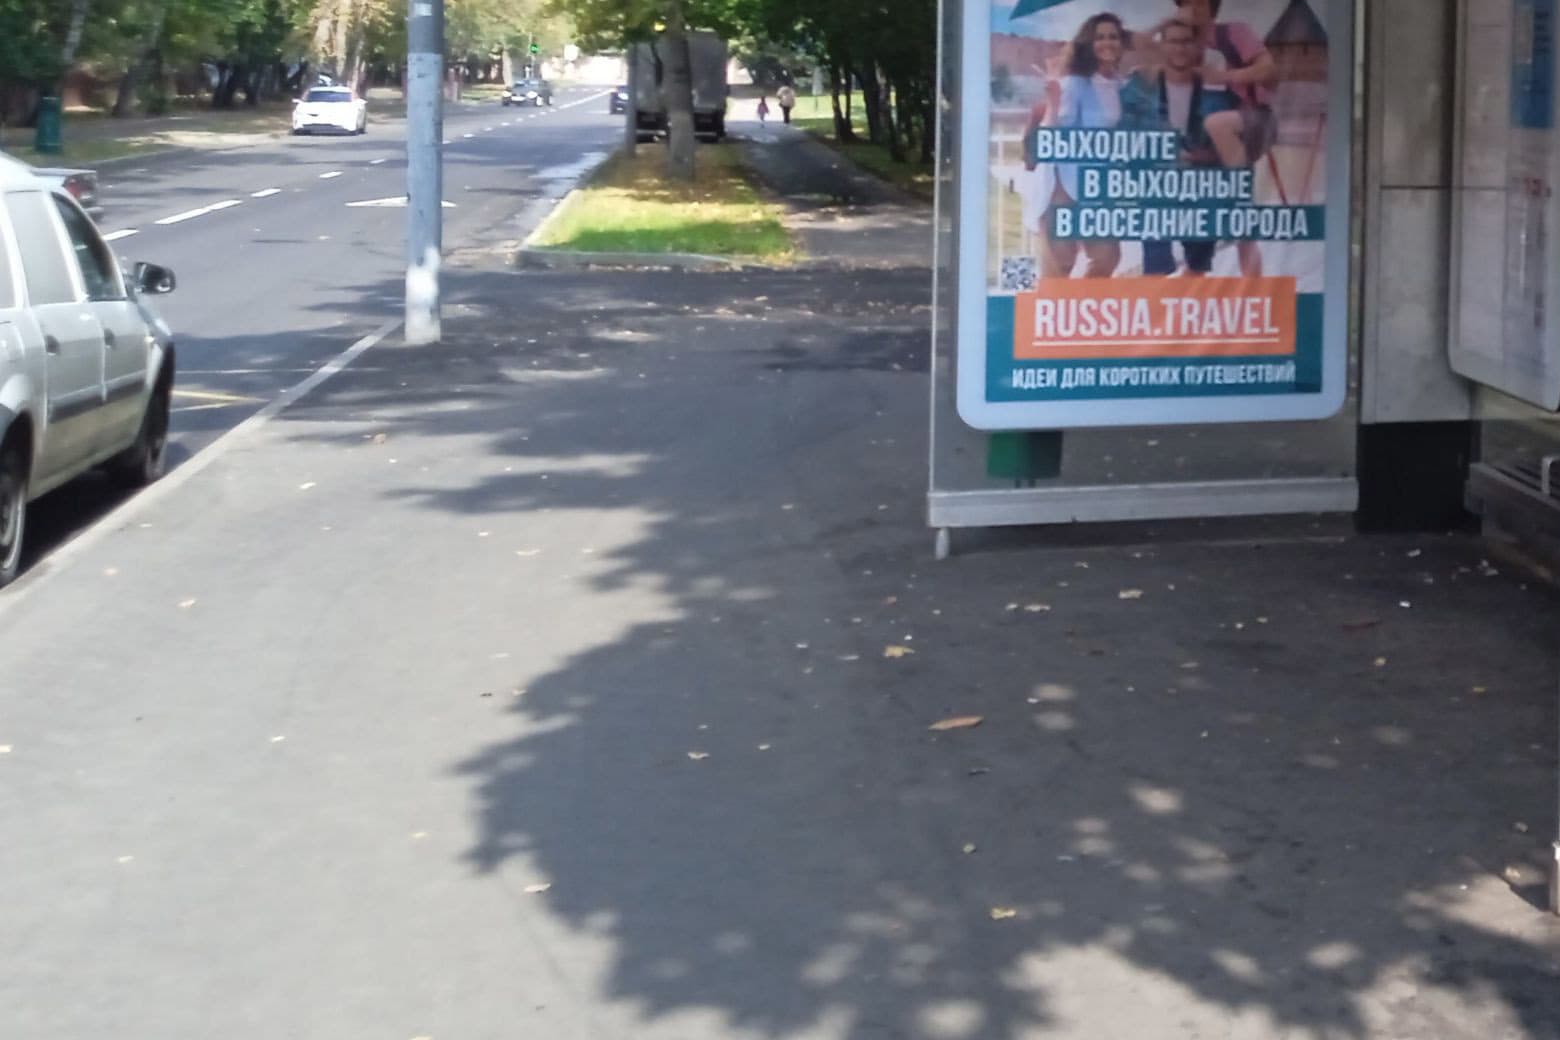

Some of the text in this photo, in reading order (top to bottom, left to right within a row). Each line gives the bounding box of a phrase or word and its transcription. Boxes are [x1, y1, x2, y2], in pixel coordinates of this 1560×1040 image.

[1037, 129, 1177, 161] ВЫХОДИТЕ
[1083, 168, 1252, 202] В ВЫХОДНЫЕ
[1055, 206, 1309, 239] В СОСЕДНИЕ ГОРОДА
[1034, 296, 1281, 339] RUSSIA.TRAVEL
[1012, 360, 1296, 390] ИДЕИ ДЛЯ КОРОТКИХ ПУТЕШЕСТВИЙ
